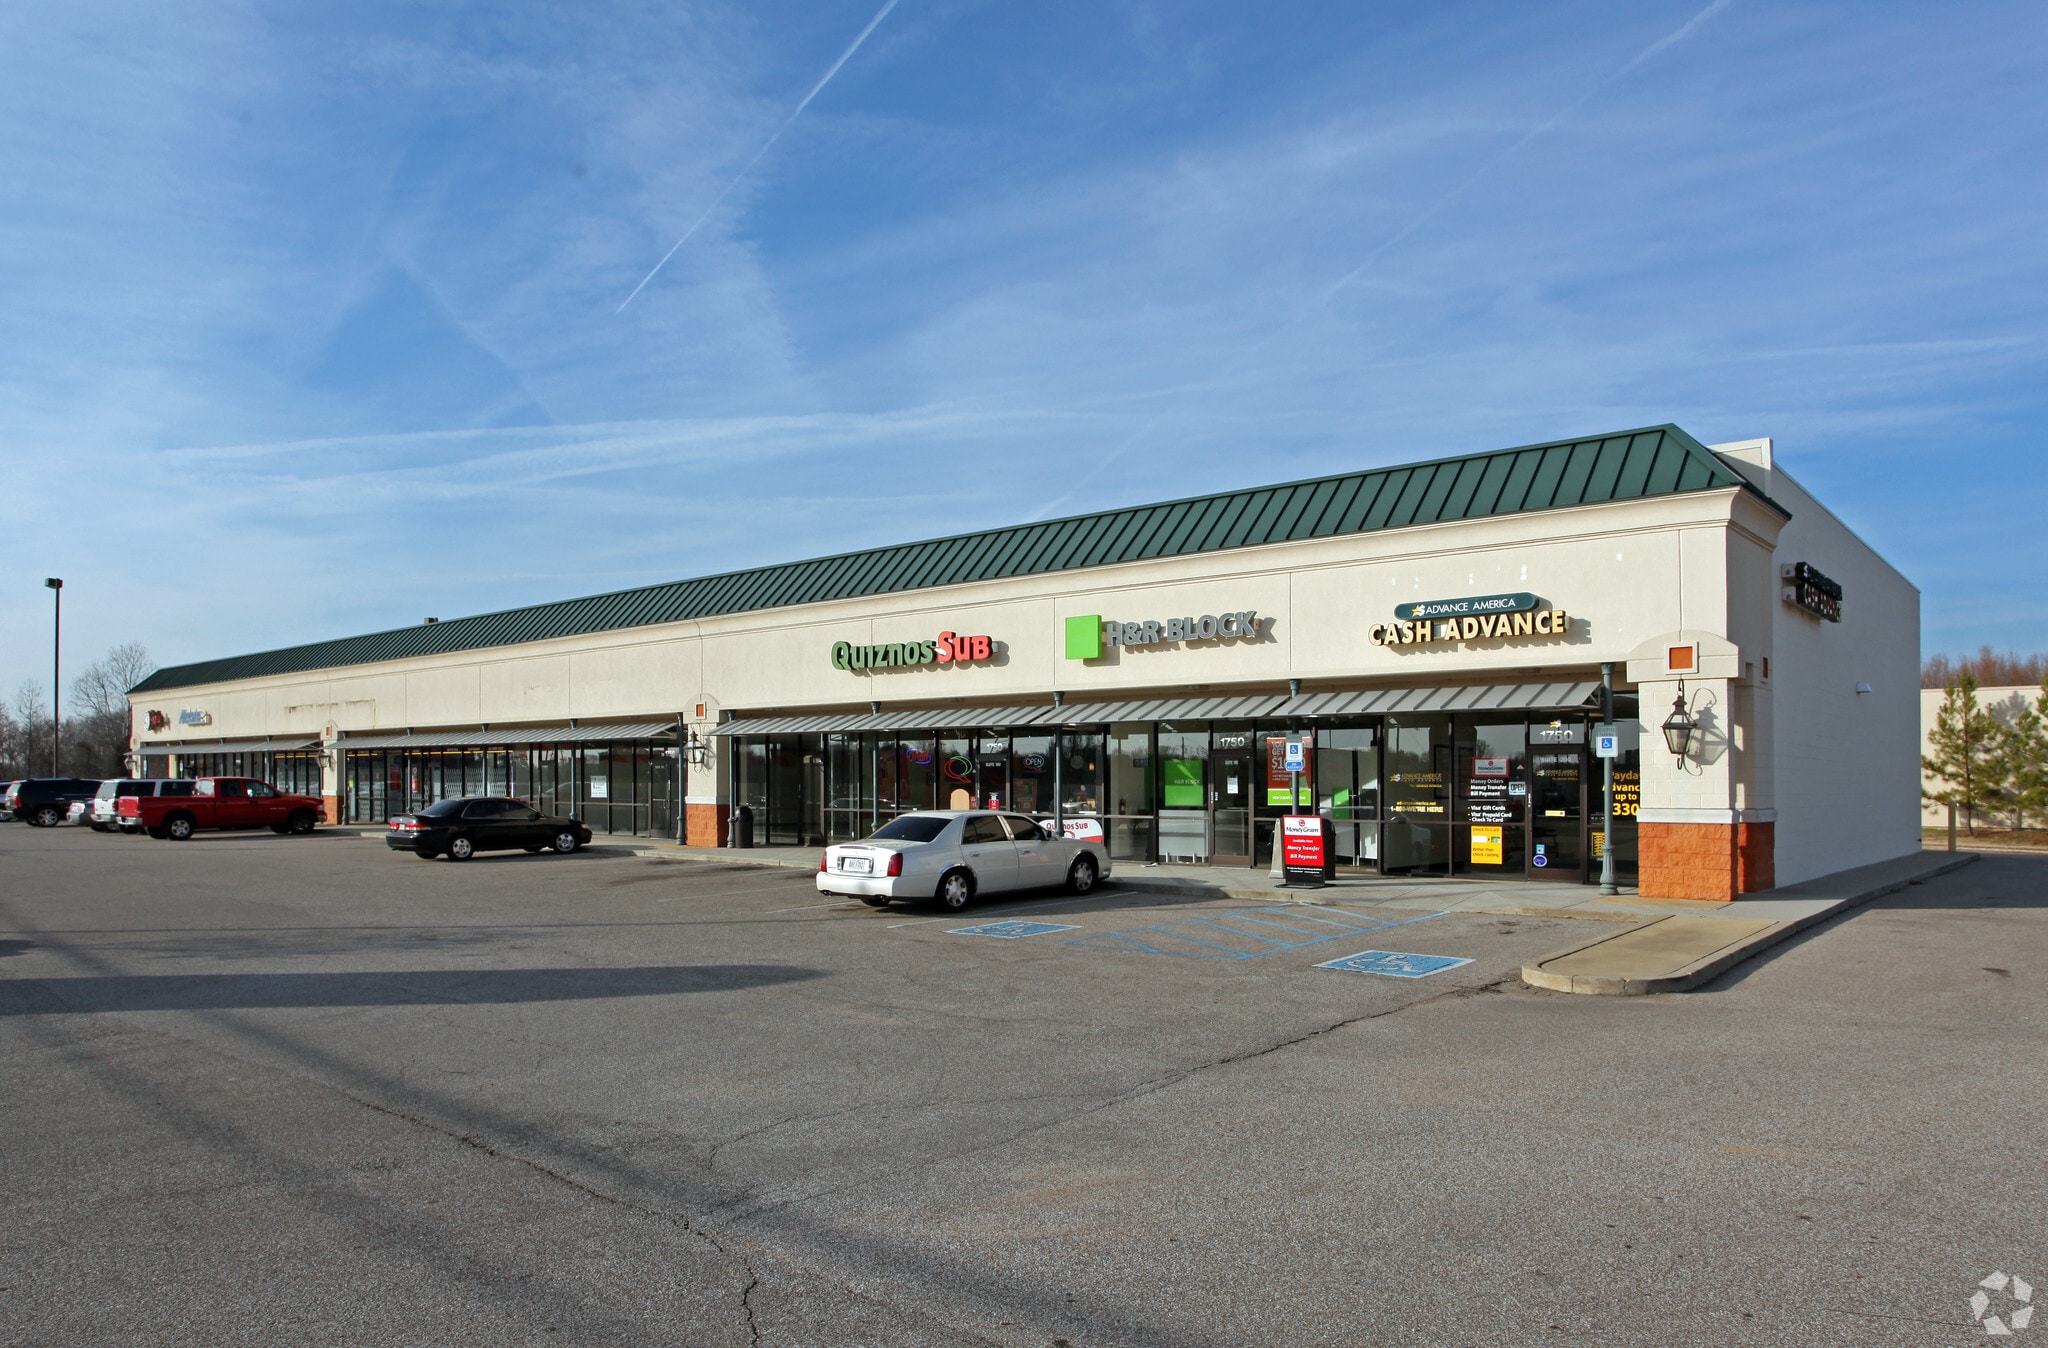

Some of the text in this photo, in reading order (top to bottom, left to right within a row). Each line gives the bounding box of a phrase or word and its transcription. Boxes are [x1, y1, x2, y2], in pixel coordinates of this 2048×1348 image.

[1425, 598, 1516, 615] ADVANCE AMERICA
[1106, 611, 1257, 647] H&R BLOCK
[1368, 610, 1567, 646] CASH ADVANCE
[1540, 730, 1573, 741] 1750
[1220, 737, 1245, 747] 1750
[1025, 758, 1042, 766] OPEN
[1510, 783, 1525, 791] OPEN
[1615, 793, 1627, 802] up
[1046, 823, 1075, 831] Qunos
